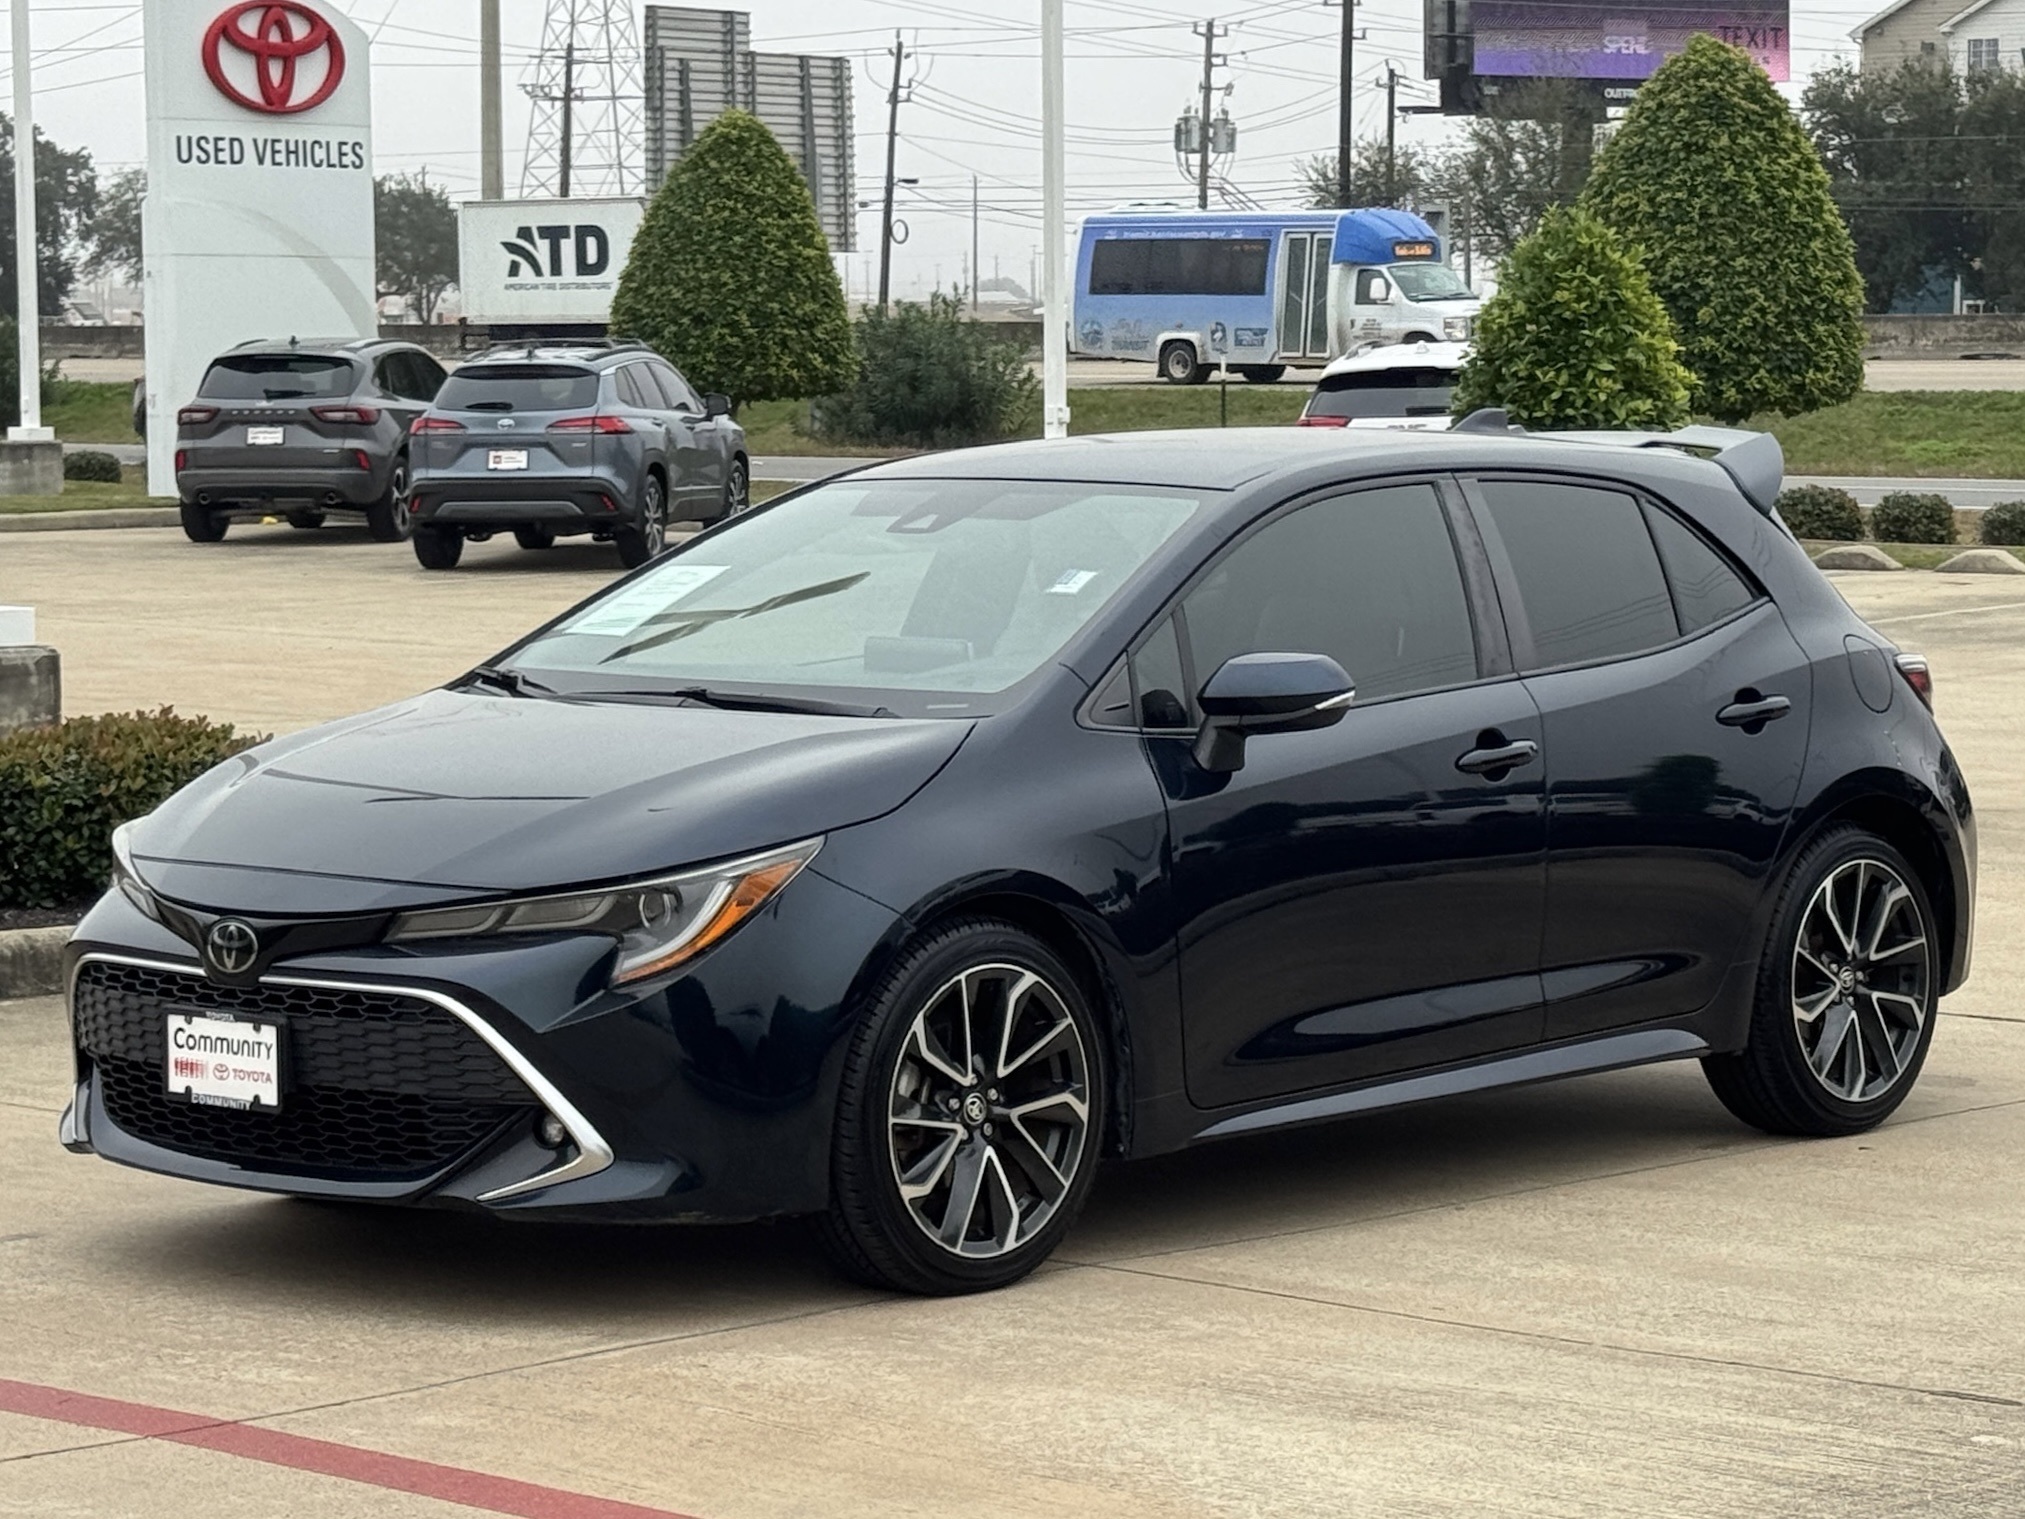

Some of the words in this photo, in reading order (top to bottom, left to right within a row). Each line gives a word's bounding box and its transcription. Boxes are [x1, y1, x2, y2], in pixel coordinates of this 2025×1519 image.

[1718, 26, 1783, 49] TEXIT
[176, 135, 244, 165] USED
[252, 138, 364, 169] VEHICLES
[500, 225, 610, 277] ATD
[232, 1068, 273, 1084] TOYOTA
[191, 1093, 251, 1111] COMMUNITY
